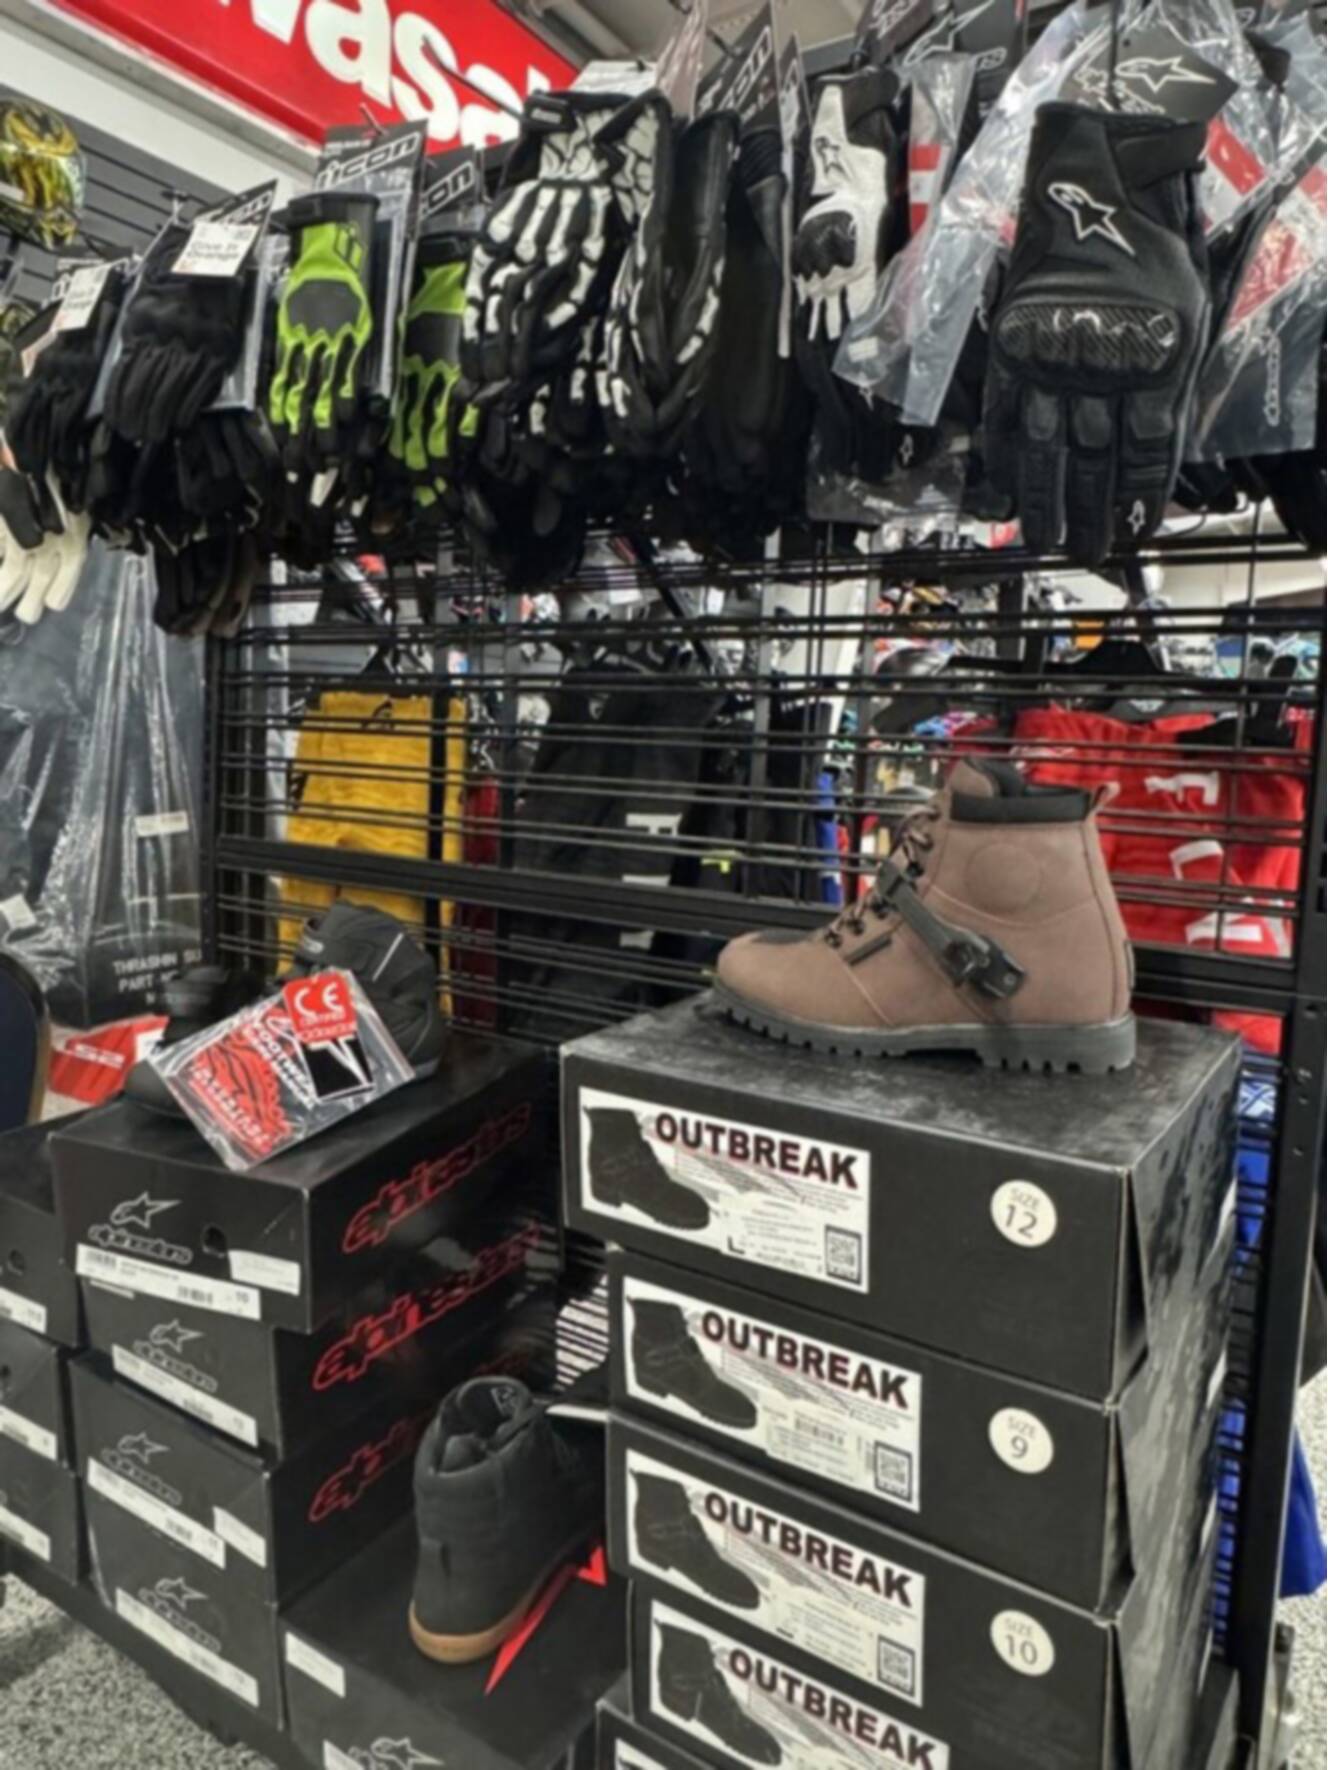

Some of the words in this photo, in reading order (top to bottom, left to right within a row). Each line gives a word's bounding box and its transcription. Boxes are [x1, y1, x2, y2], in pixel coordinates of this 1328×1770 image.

[655, 1112, 859, 1190] OUTBREAK
[1005, 1203, 1038, 1240] 12
[702, 1310, 909, 1410] OUTBREAK
[1010, 1435, 1029, 1459] 9
[704, 1491, 912, 1609] OUTBREAK
[1005, 1632, 1038, 1666] 10
[729, 1648, 938, 1770] OUTBREAK
